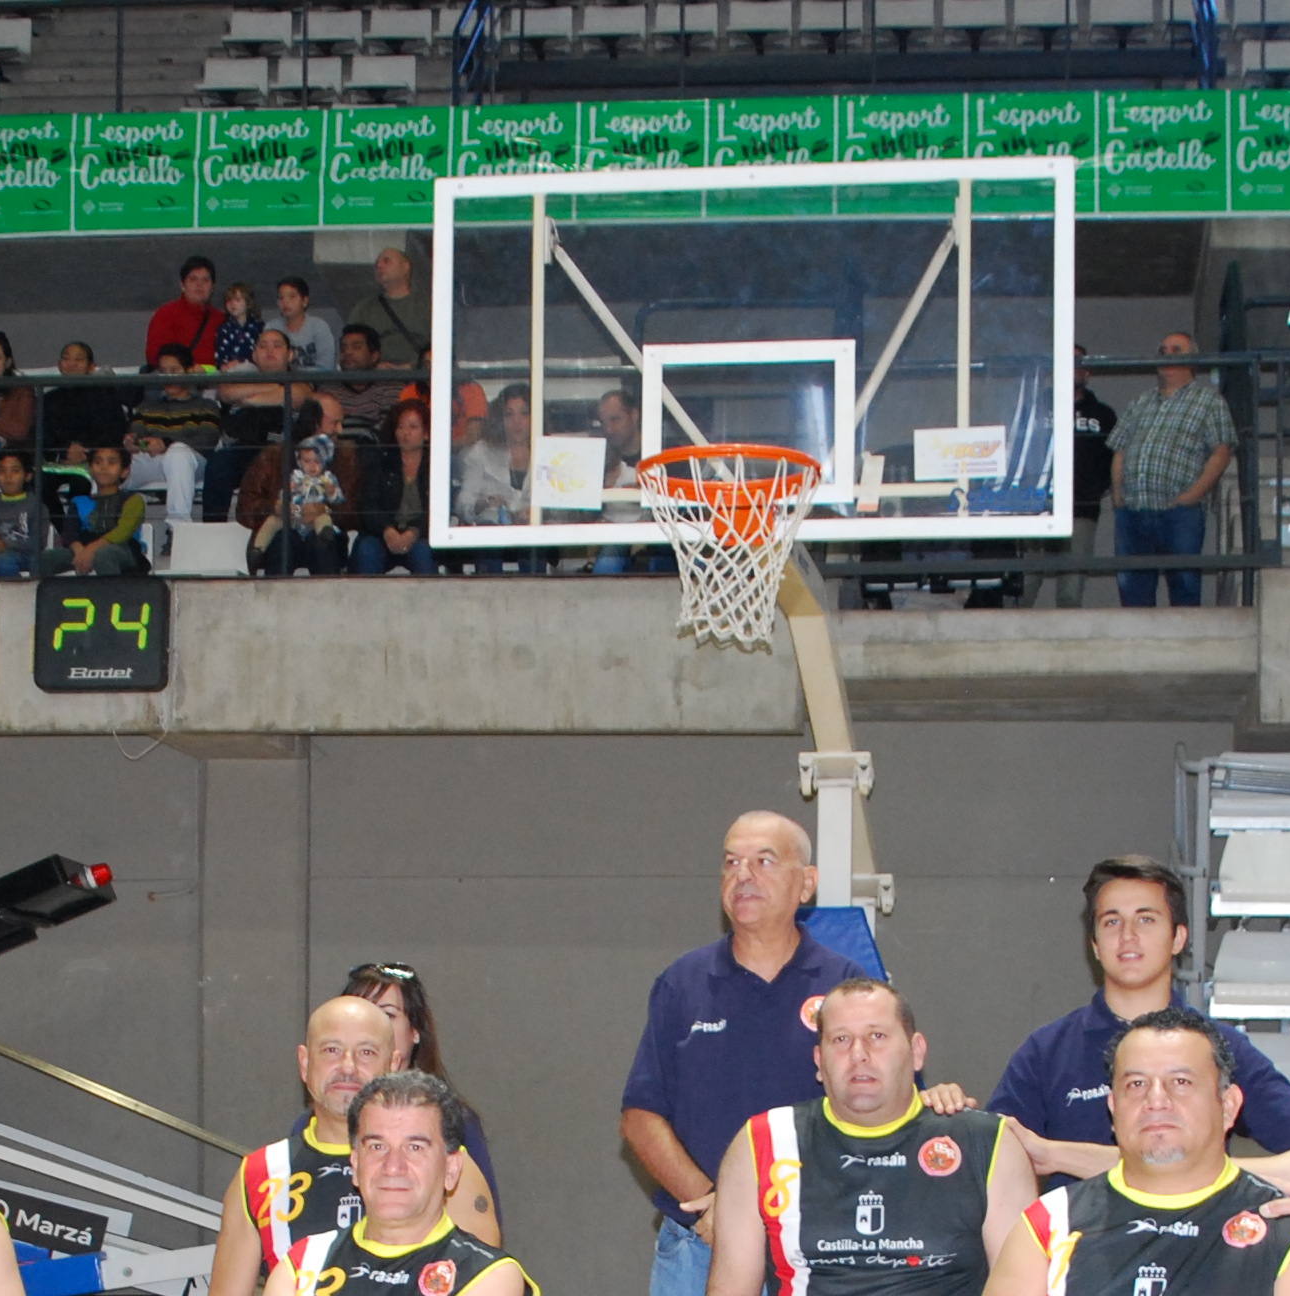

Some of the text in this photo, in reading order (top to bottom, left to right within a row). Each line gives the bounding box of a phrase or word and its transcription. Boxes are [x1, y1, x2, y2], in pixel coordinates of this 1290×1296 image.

[53, 598, 151, 651] 24
[67, 667, 134, 679] Bodet
[866, 1151, 907, 1168] rasán
[257, 1171, 313, 1229] 23
[763, 1158, 803, 1217] 8
[15, 1208, 93, 1246] Marzá
[878, 1237, 925, 1251] Mancha
